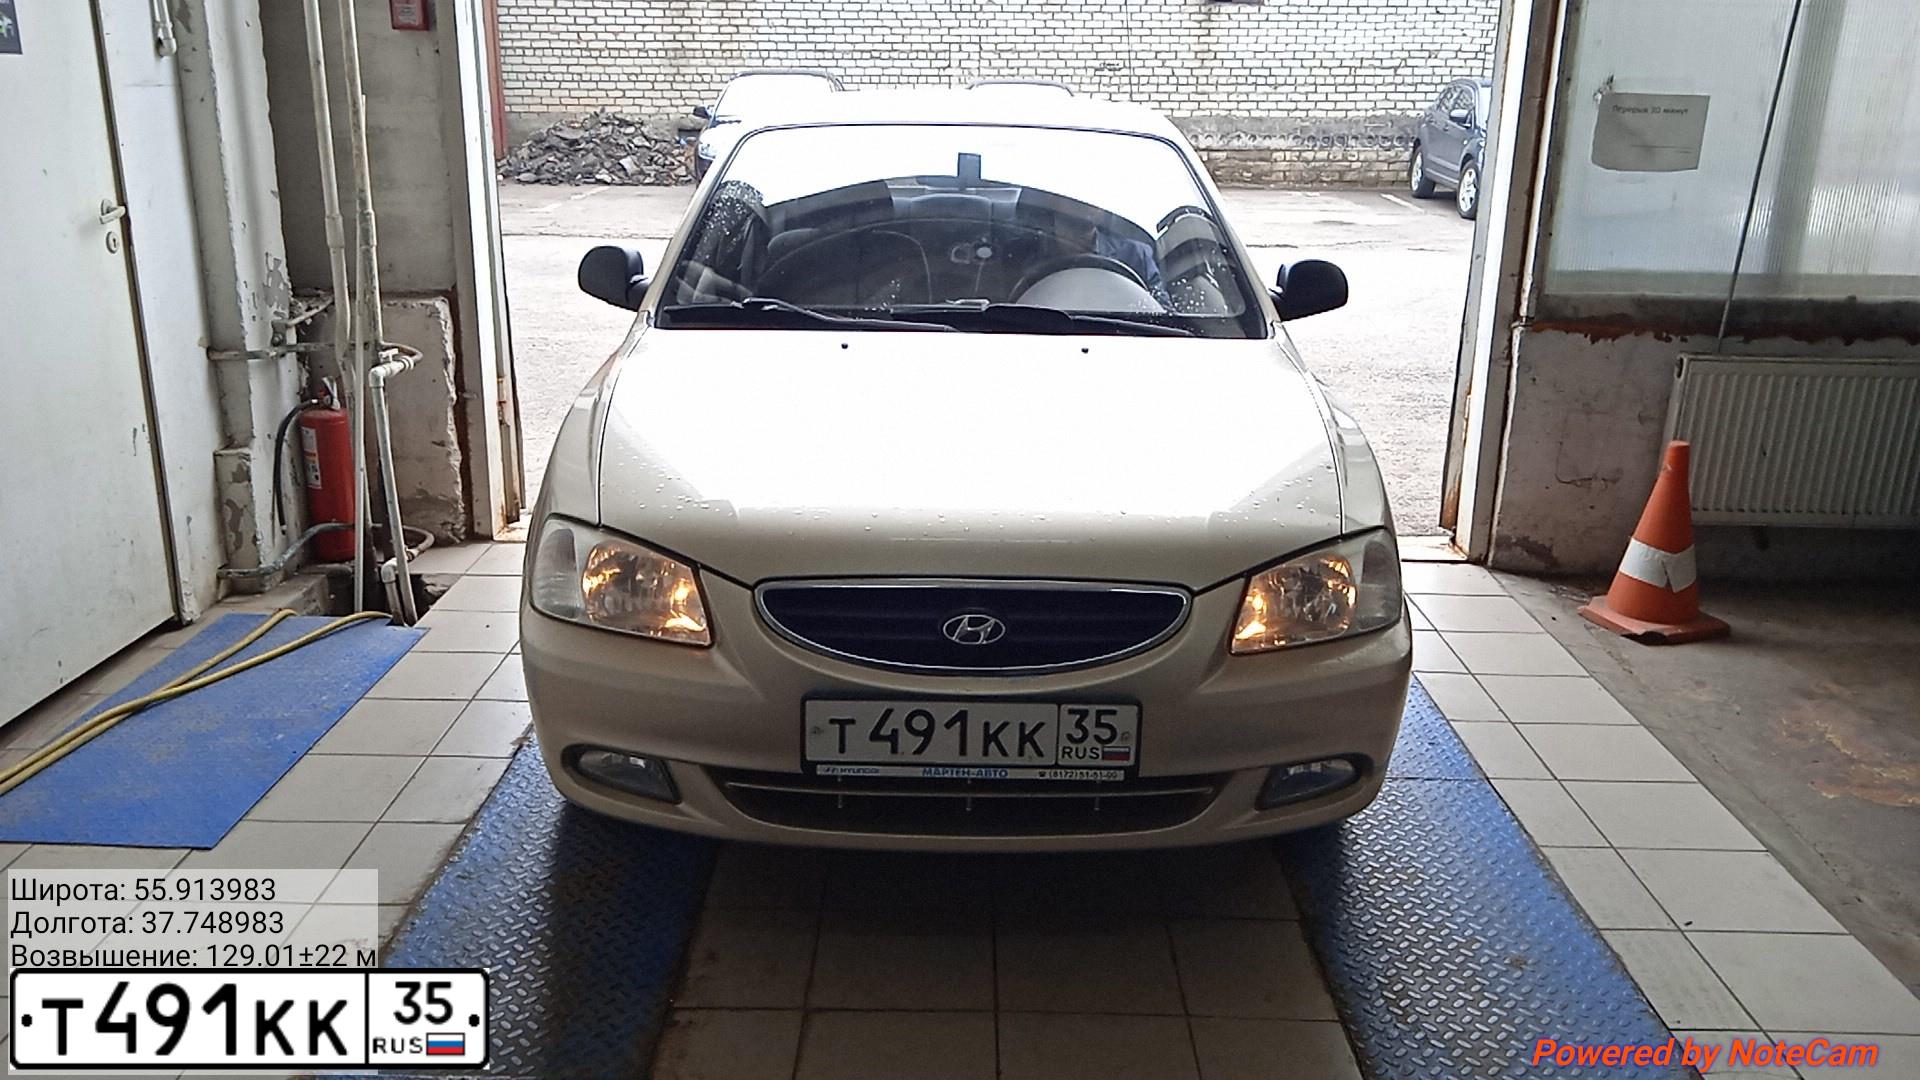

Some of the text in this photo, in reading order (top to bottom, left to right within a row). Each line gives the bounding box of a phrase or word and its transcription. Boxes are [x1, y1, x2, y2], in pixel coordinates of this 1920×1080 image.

[1067, 709, 1119, 744] 35
[1061, 747, 1100, 760] RUS
[922, 767, 1009, 778] МАРТЕН-АВТО
